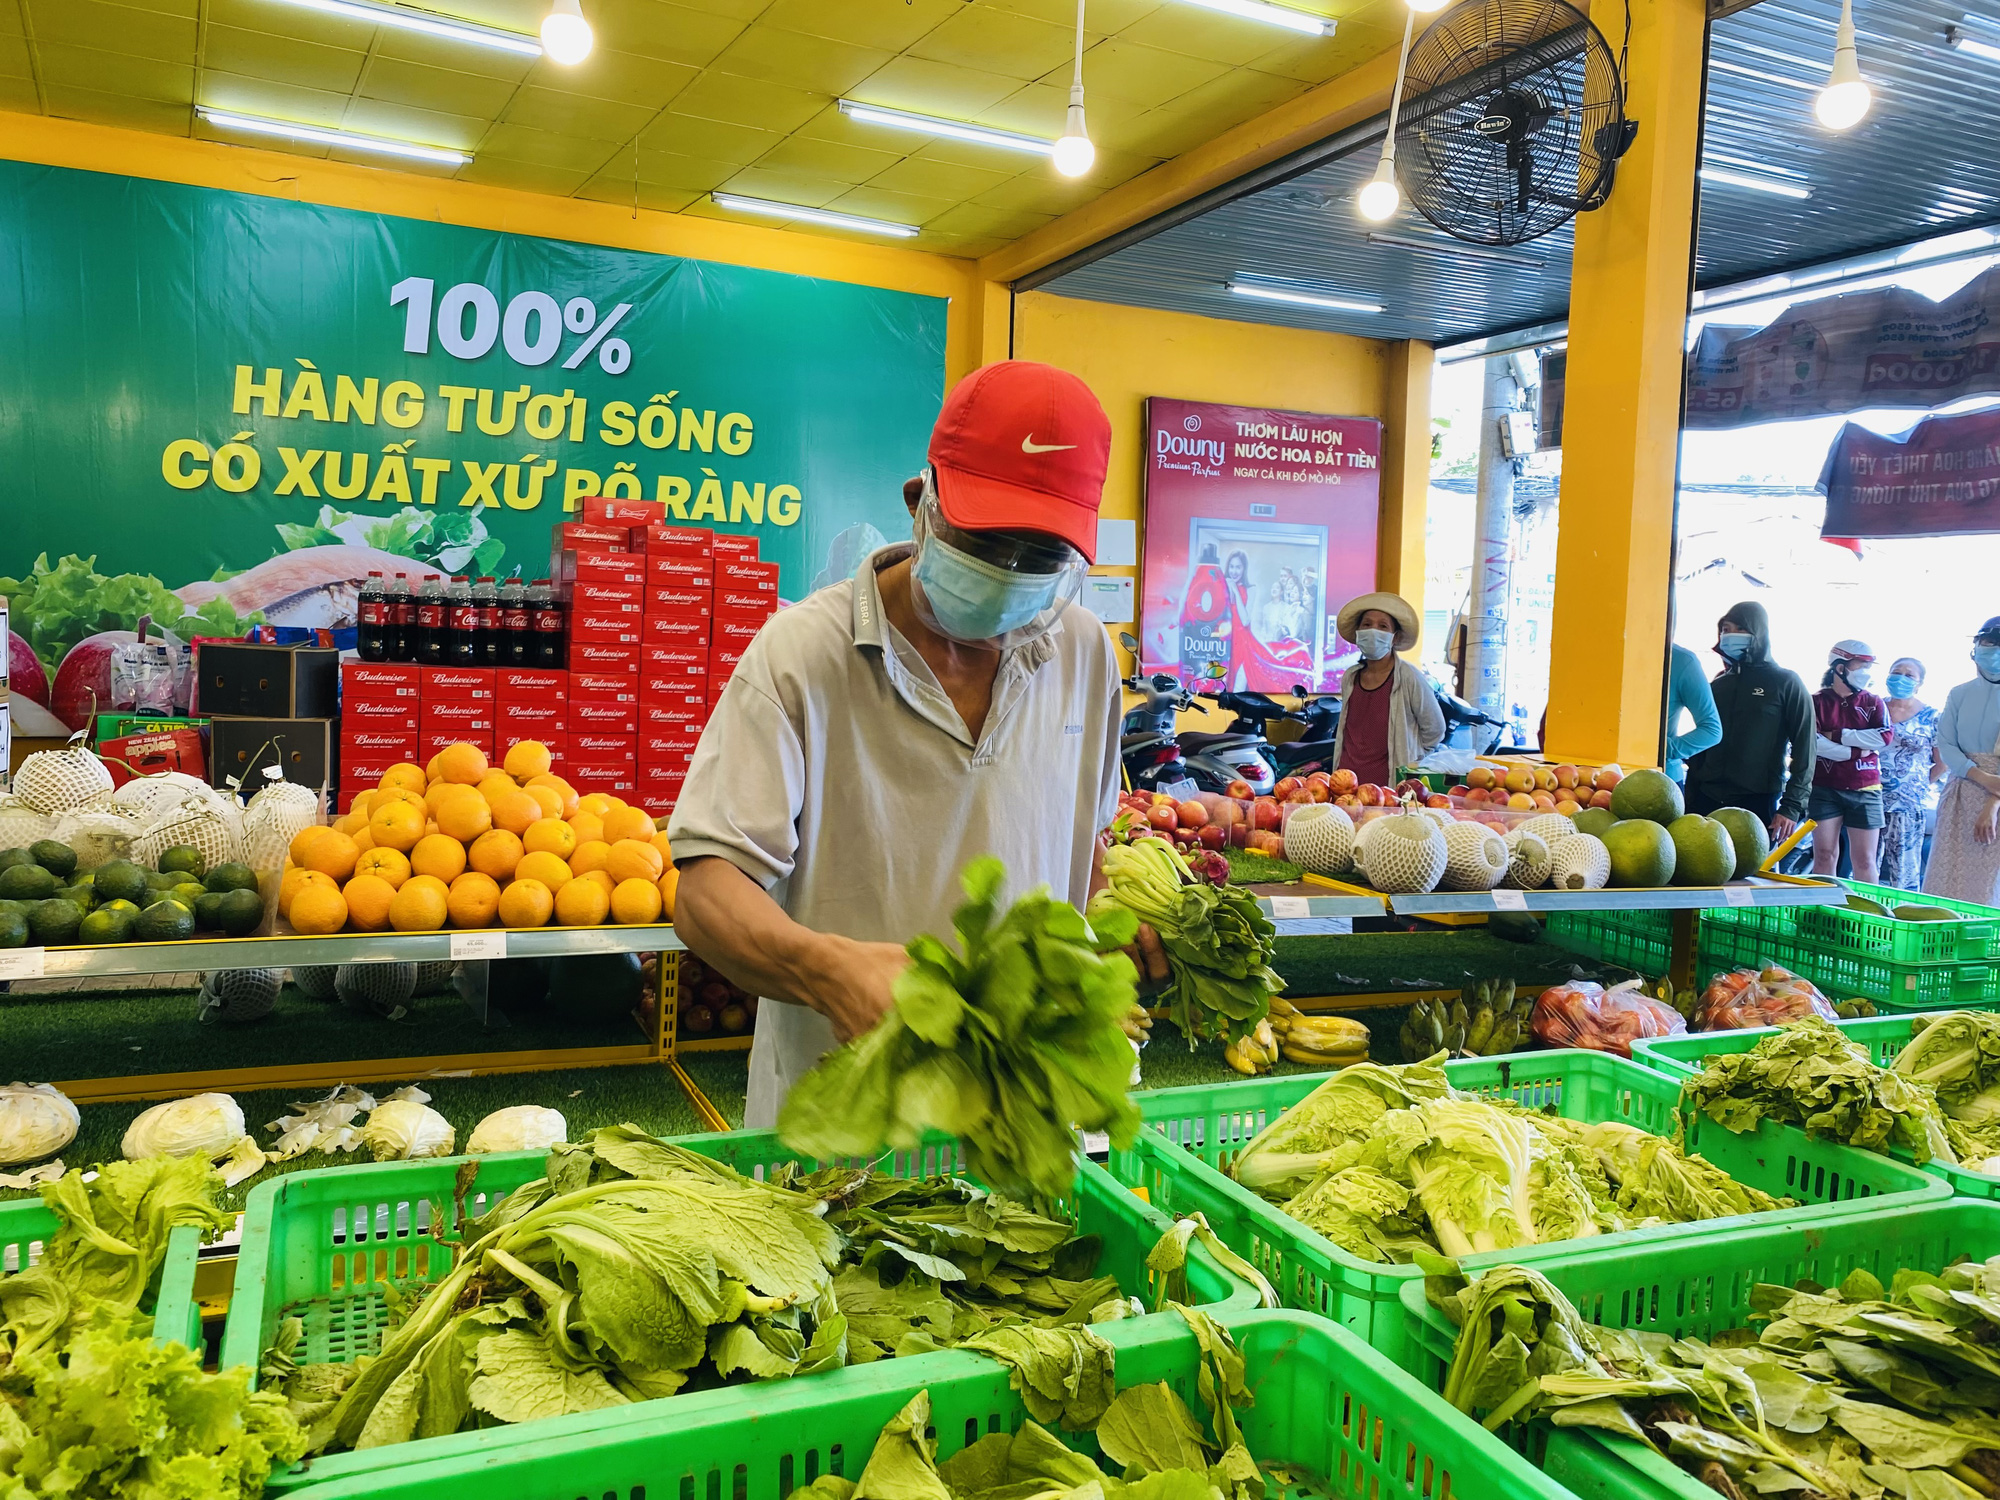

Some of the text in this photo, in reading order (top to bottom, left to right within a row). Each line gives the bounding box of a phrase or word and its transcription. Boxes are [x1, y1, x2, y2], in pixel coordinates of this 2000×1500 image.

[391, 277, 634, 376] 100%
[233, 358, 754, 457] HÀNG TƯƠI SỐNG
[1236, 422, 1342, 446] THƠM LÂU HƠN
[1157, 430, 1225, 466] Downy
[1234, 441, 1376, 469] NƯỚC HOA ĐẮT TIỀN
[1157, 454, 1191, 470] Premium
[161, 430, 261, 493] CÓ
[275, 440, 452, 506] XUẤT
[459, 453, 558, 510] XỨ
[656, 467, 801, 526] RÀNG
[1234, 467, 1341, 485] NGAY CẢ KHI ĐỔ MỒ HÔI
[574, 528, 619, 540] Budweiser
[658, 531, 704, 542] Budweiser
[588, 556, 635, 567] Budweiser
[658, 561, 703, 572] Budweiser
[726, 565, 770, 576] Budweiser
[584, 587, 632, 598] Budweiser
[656, 591, 702, 602] Budweiser
[724, 594, 768, 606] Budweiser
[860, 594, 870, 626] ZEBRA
[583, 618, 630, 628] Budweiser
[654, 620, 700, 631] Budweiser
[724, 624, 759, 634] Budwei
[1184, 636, 1226, 656] Downy
[582, 648, 630, 658] Budweiser
[652, 650, 697, 660] Budweiser
[354, 671, 407, 682] Budweiser
[432, 674, 483, 684] Budweiser
[508, 675, 557, 686] Budweiser
[580, 678, 627, 688] Budweiser
[650, 680, 696, 690] Budweiser
[355, 703, 407, 713] Budweiser
[432, 705, 483, 715] Budweiser
[507, 706, 556, 716] Budweiser
[579, 708, 626, 718] Budweiser
[649, 710, 695, 719] Budweiser
[128, 734, 172, 746] NEW ZEALAND
[354, 734, 406, 745] Budweiser
[579, 738, 626, 748] Budweiser
[649, 740, 695, 749] Budweiser
[125, 740, 176, 758] apples
[578, 768, 625, 777] Budweiser
[648, 768, 687, 778] Budweis
